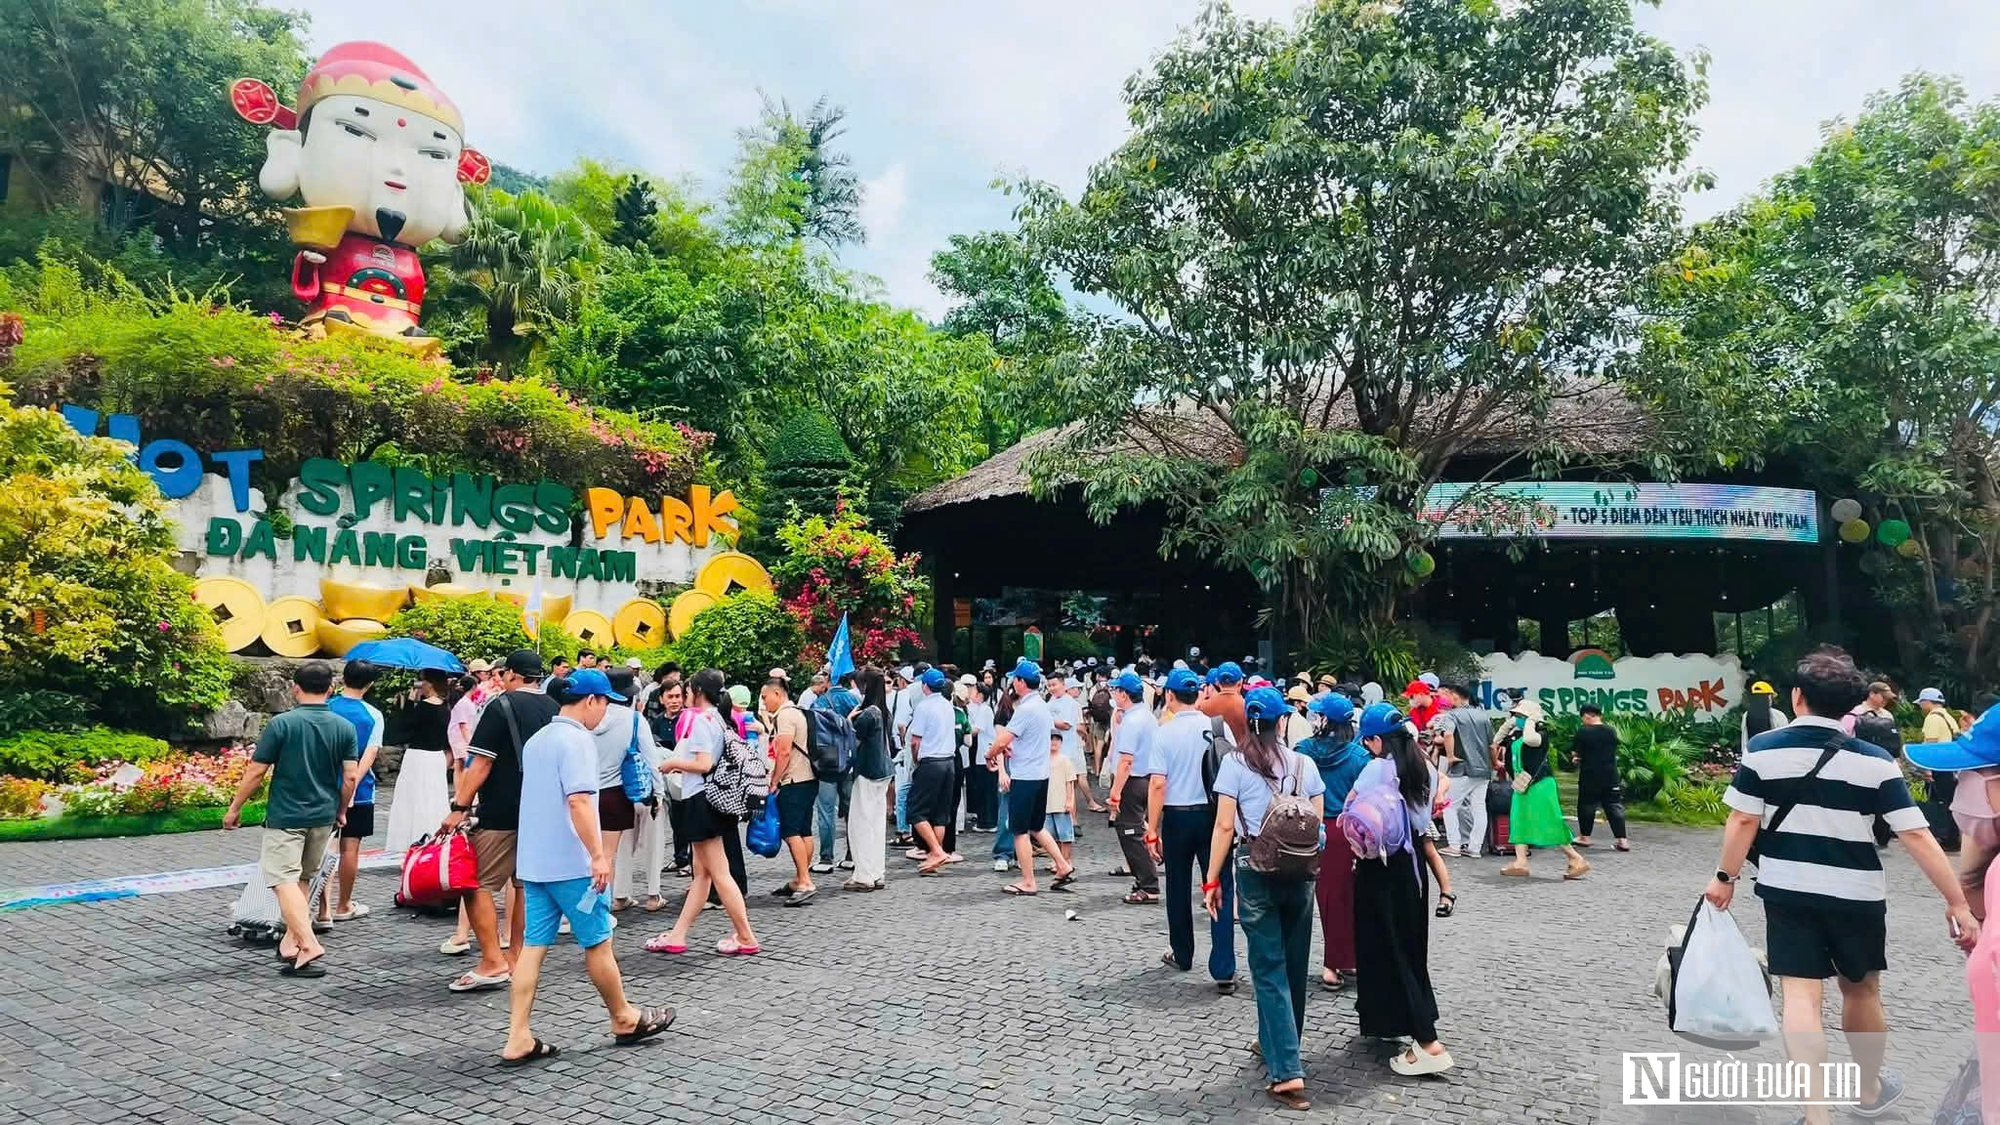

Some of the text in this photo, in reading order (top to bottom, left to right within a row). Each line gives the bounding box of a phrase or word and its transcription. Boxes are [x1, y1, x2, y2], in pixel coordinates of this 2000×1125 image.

[586, 484, 741, 548] PARK
[1571, 507, 1597, 524] TOP
[1601, 507, 1609, 525] 5
[1786, 512, 1809, 530] NAM
[205, 509, 277, 560] ĐÀ
[449, 530, 545, 586] VIỆT
[548, 545, 636, 582] NAM
[1656, 677, 1729, 712] PARK
